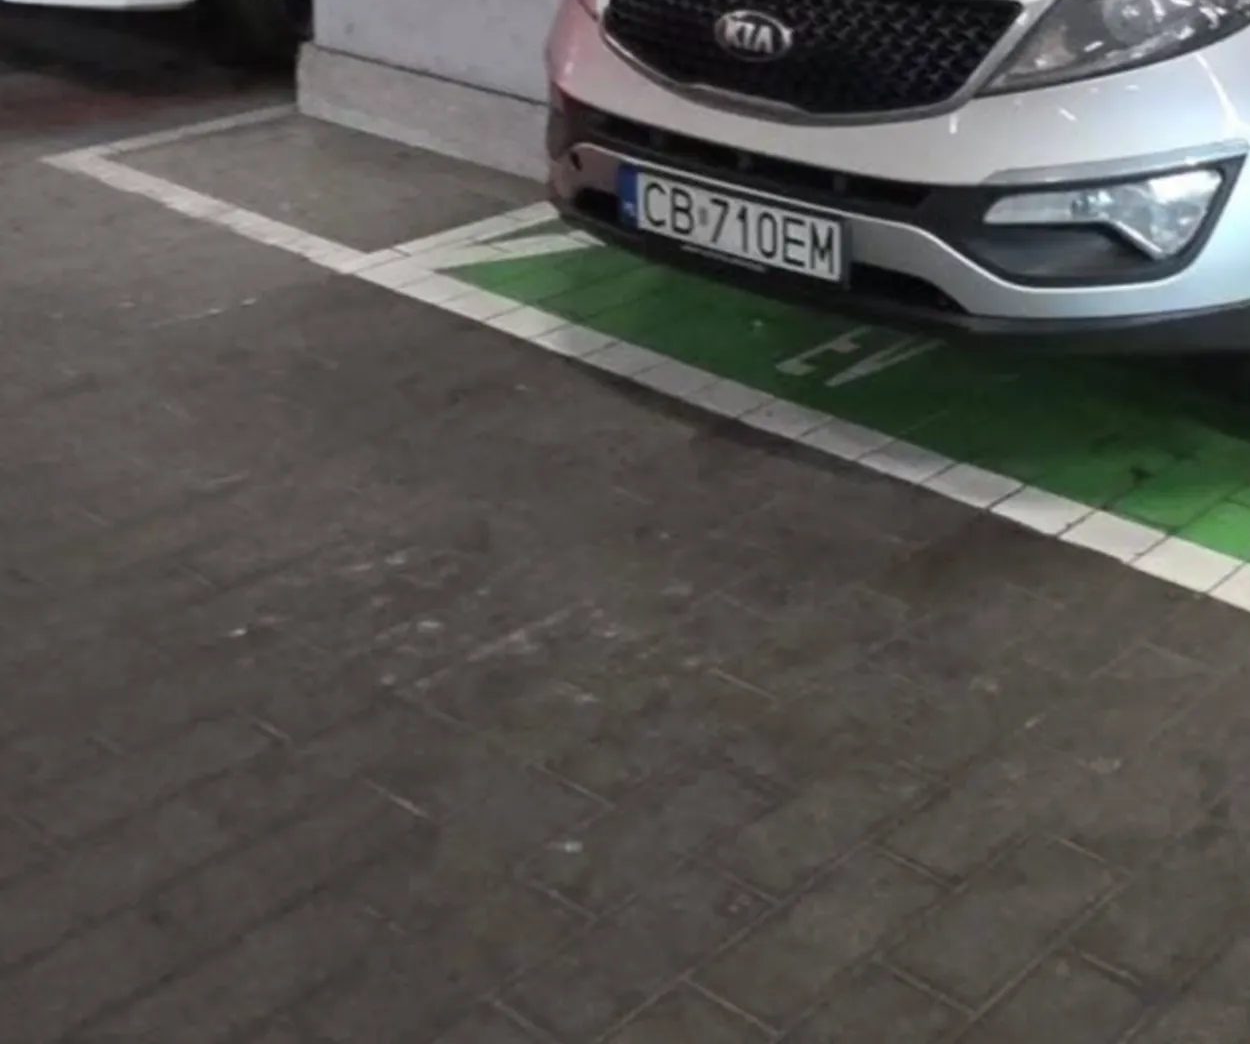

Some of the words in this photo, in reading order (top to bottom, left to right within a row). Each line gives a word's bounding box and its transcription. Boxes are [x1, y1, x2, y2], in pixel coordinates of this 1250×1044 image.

[724, 19, 775, 54] KIA
[644, 181, 695, 235] CB
[709, 197, 834, 275] 710EM
[774, 324, 948, 387] EV
